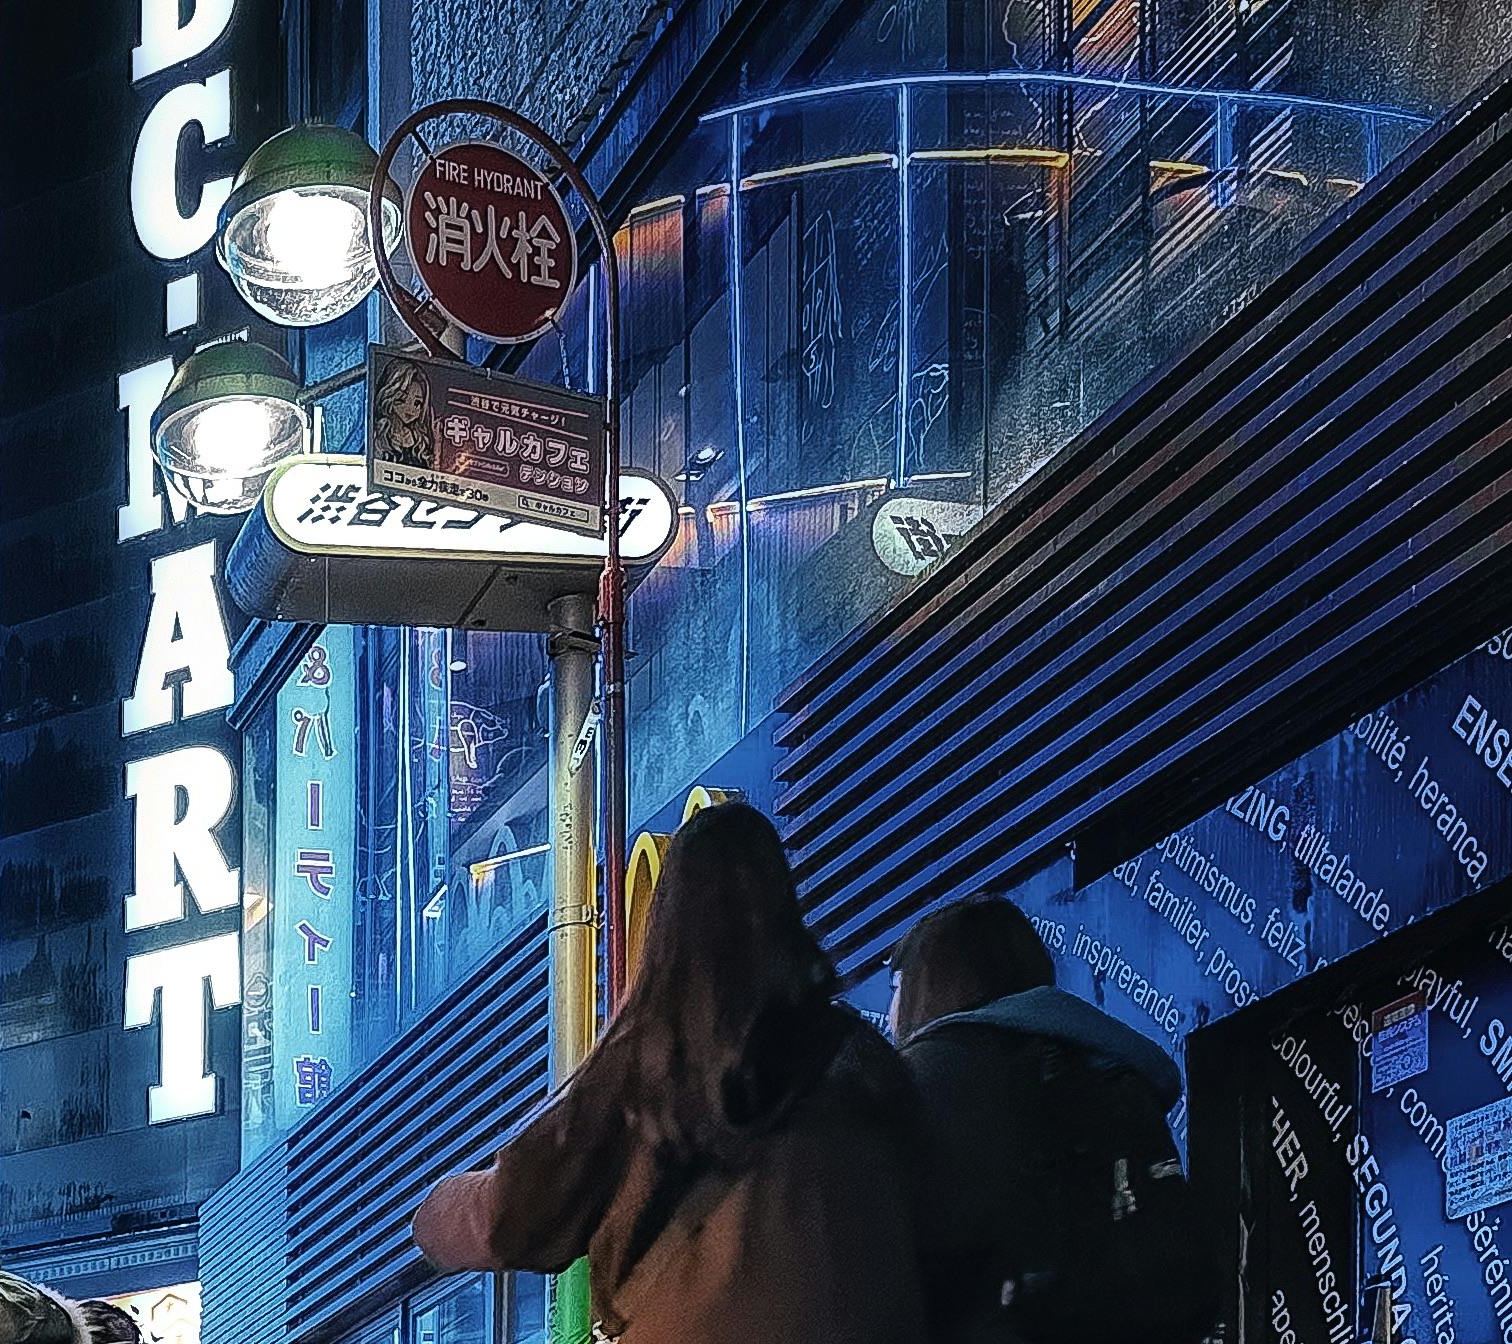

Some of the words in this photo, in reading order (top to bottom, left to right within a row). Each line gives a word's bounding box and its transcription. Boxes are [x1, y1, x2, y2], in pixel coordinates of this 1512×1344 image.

[435, 158, 468, 185] FIRE
[475, 163, 545, 201] HYDRANT
[424, 191, 562, 290] 消火栓
[444, 415, 589, 474] ギャルカフェ
[1143, 869, 1210, 963] familier,
[1260, 907, 1306, 977] feliz,
[1072, 924, 1180, 1044] inspirerande,
